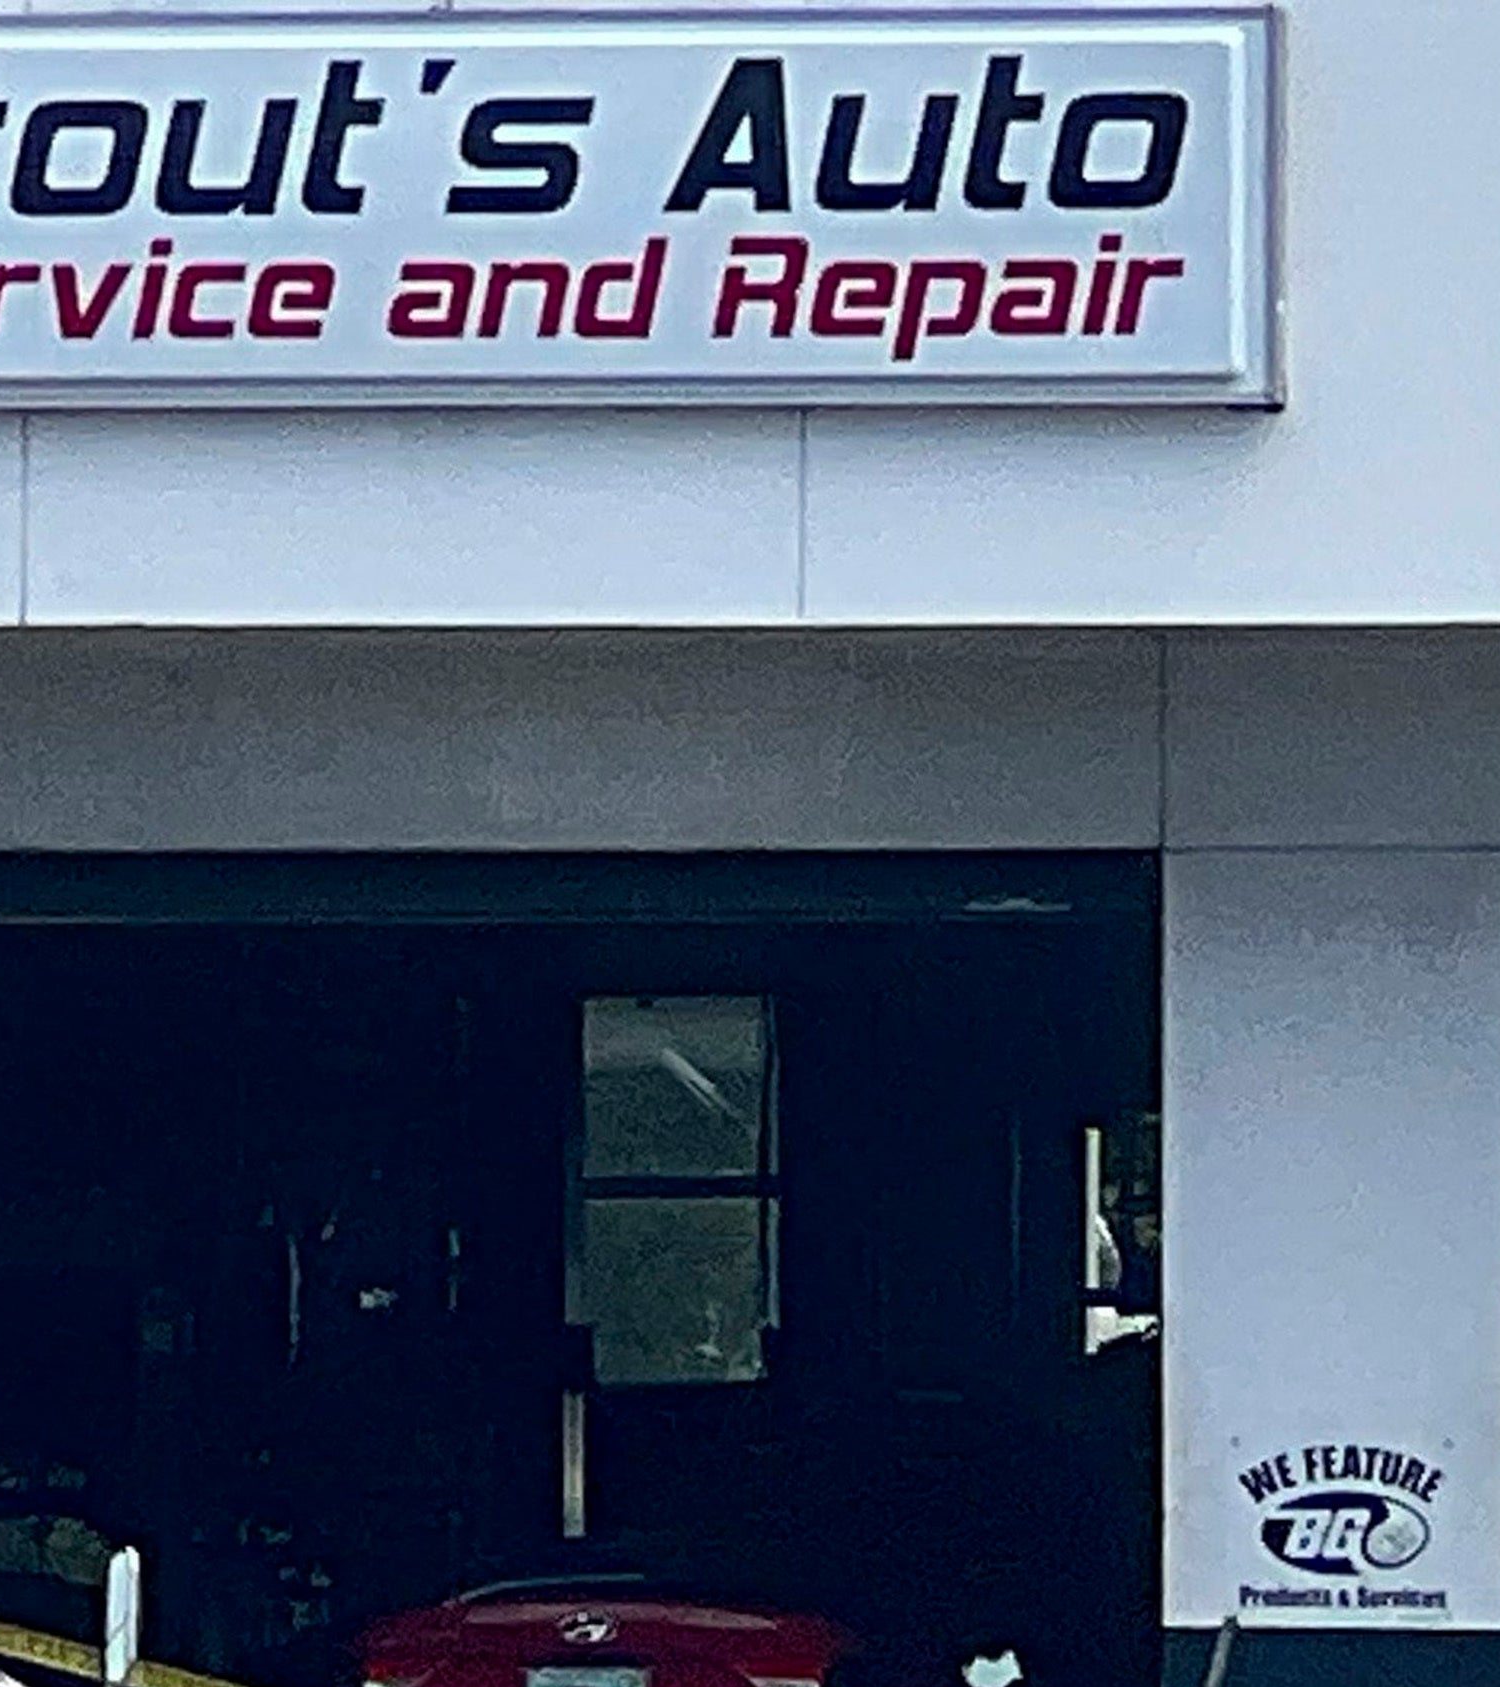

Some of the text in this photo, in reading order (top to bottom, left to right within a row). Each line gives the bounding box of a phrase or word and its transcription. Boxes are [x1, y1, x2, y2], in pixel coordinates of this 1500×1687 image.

[663, 54, 1189, 214] Auto
[387, 236, 669, 340] and
[711, 234, 1185, 362] Repair
[1238, 1444, 1445, 1504] WE FEATURE
